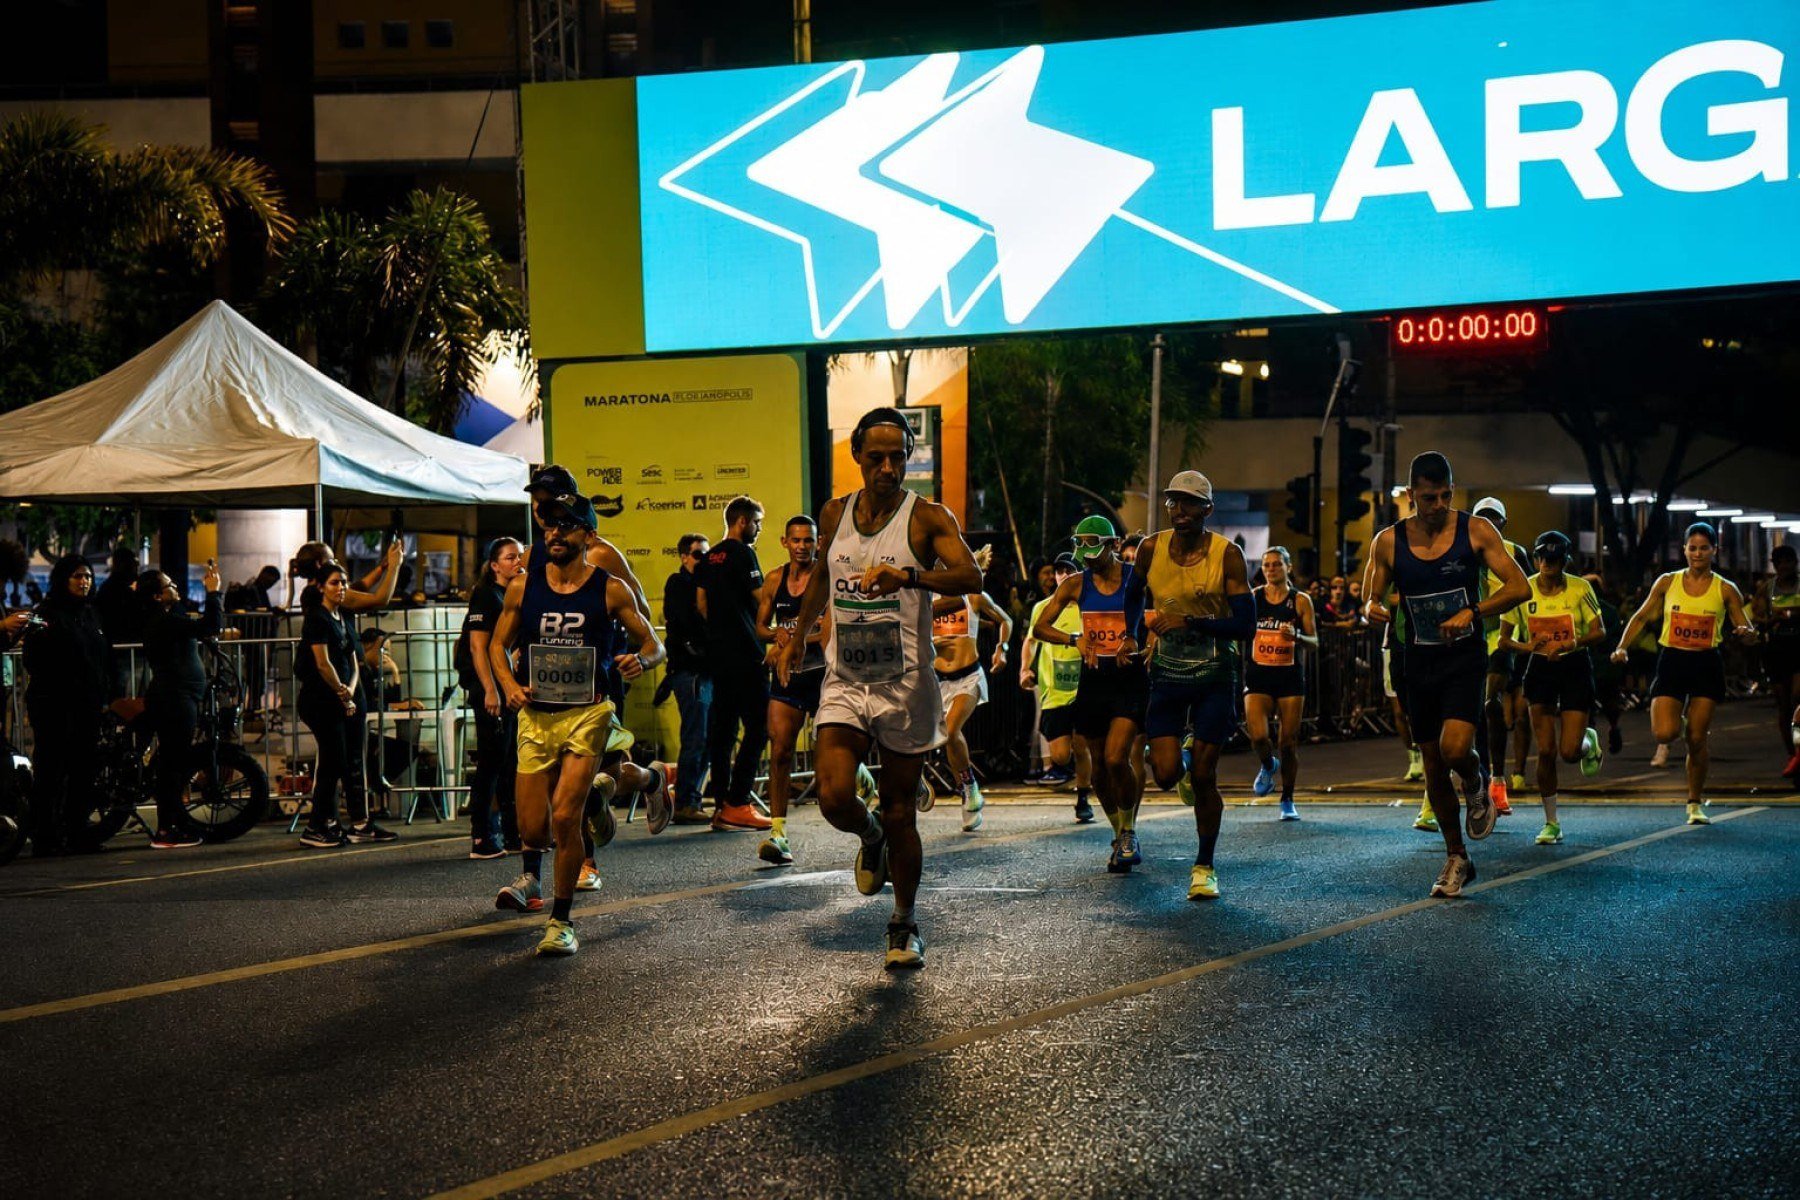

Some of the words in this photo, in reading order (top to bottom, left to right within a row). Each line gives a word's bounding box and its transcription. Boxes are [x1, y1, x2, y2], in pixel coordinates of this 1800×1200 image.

[1211, 39, 1800, 231] LARG
[1398, 312, 1536, 343] 0:0:00:00
[584, 392, 671, 407] MARATONA
[587, 467, 622, 477] POWER
[540, 612, 586, 637] B2
[843, 647, 894, 664] 0015
